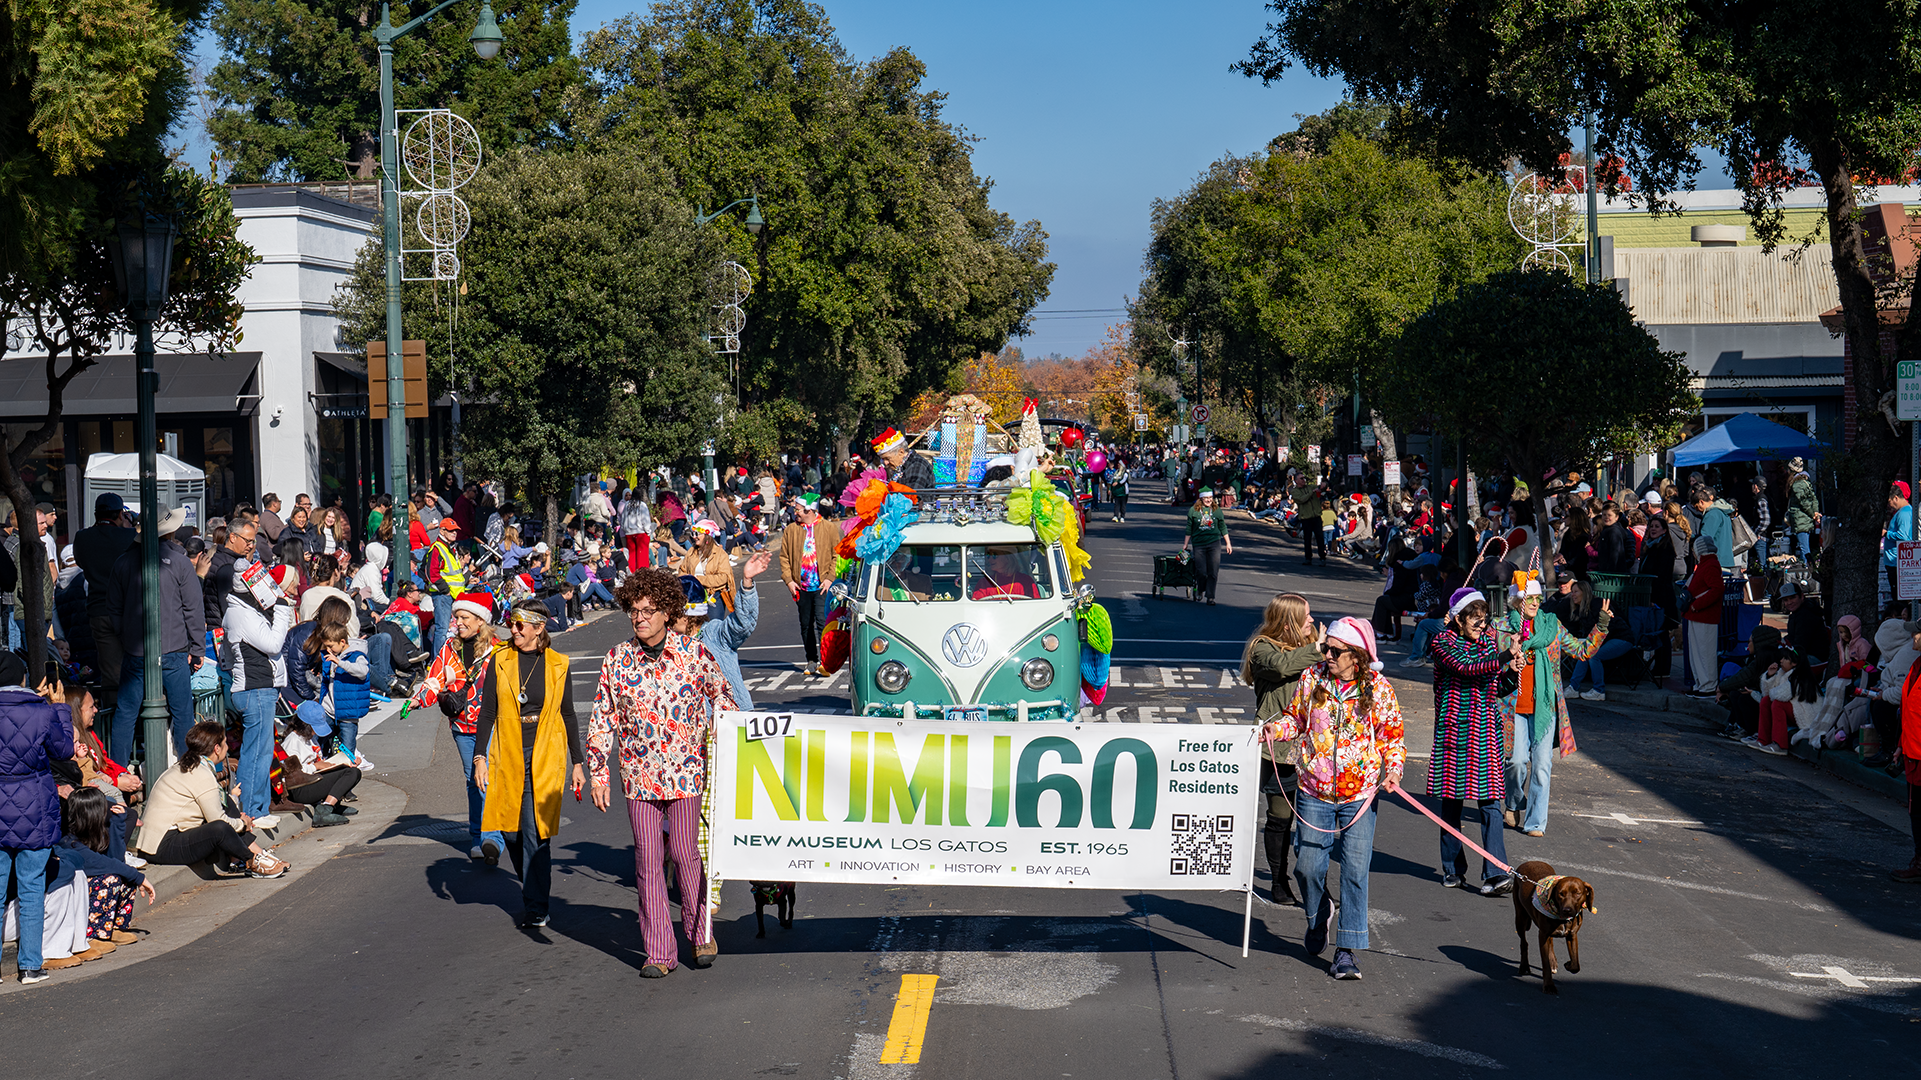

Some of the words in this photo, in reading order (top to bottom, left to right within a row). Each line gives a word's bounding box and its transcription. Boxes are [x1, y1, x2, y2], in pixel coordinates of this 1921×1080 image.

[1900, 364, 1914, 377] 30
[1905, 383, 1920, 391] 8:00
[1900, 393, 1908, 401] TO
[1900, 550, 1912, 559] NO
[750, 715, 792, 738] 107
[1178, 739, 1209, 752] Free
[1213, 740, 1233, 753] for
[1170, 759, 1195, 773] Los
[1199, 760, 1240, 774] Gatos
[1169, 779, 1239, 795] Residents
[733, 835, 782, 847] NEW
[786, 836, 883, 849] MUSEUM
[891, 838, 932, 850] LOS
[938, 839, 1008, 853] GATOS
[1040, 842, 1081, 854] EST.
[1087, 842, 1129, 855] 1965
[788, 860, 815, 869] ART
[840, 861, 919, 871] INNOVATION
[944, 863, 1002, 873] HISTORY
[1026, 865, 1052, 875] BAY
[1055, 866, 1091, 876] AREA
